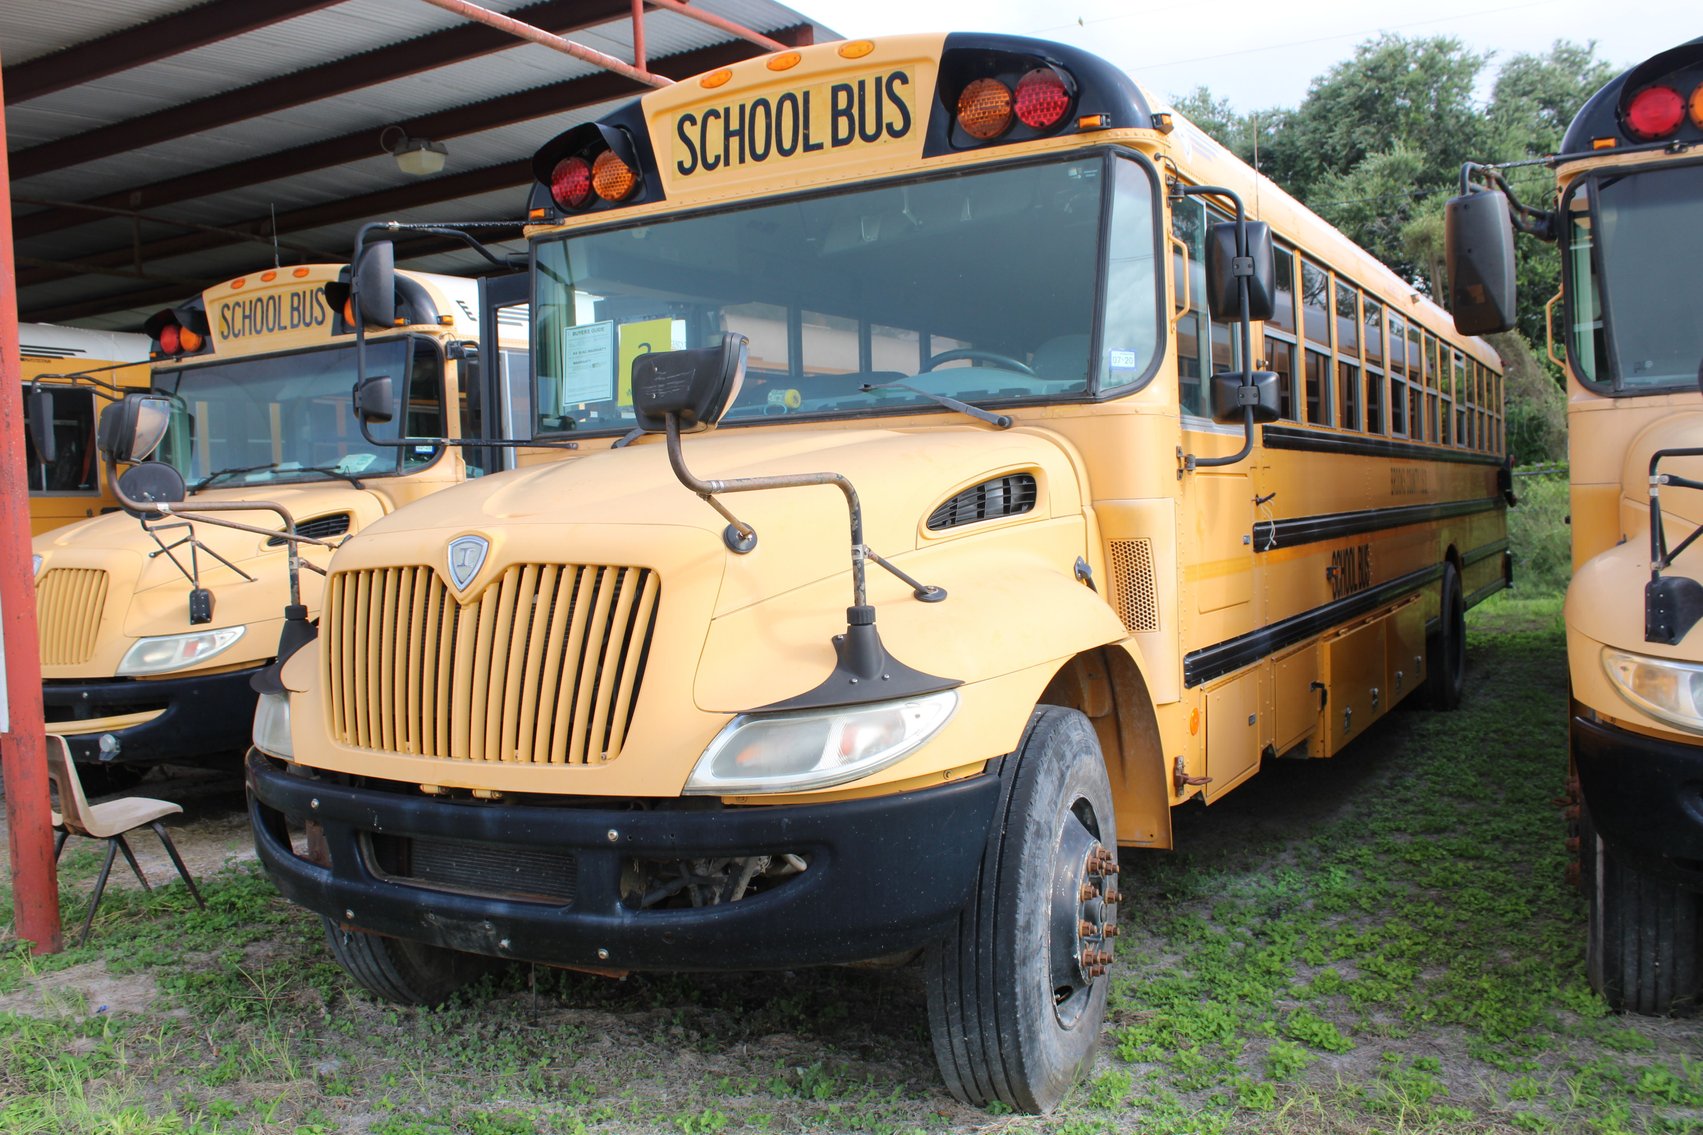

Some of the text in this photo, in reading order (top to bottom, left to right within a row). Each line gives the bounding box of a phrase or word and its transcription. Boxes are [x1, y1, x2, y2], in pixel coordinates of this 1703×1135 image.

[676, 70, 911, 176] SCHOOL BUS
[221, 287, 326, 340] SCHOOL BUS
